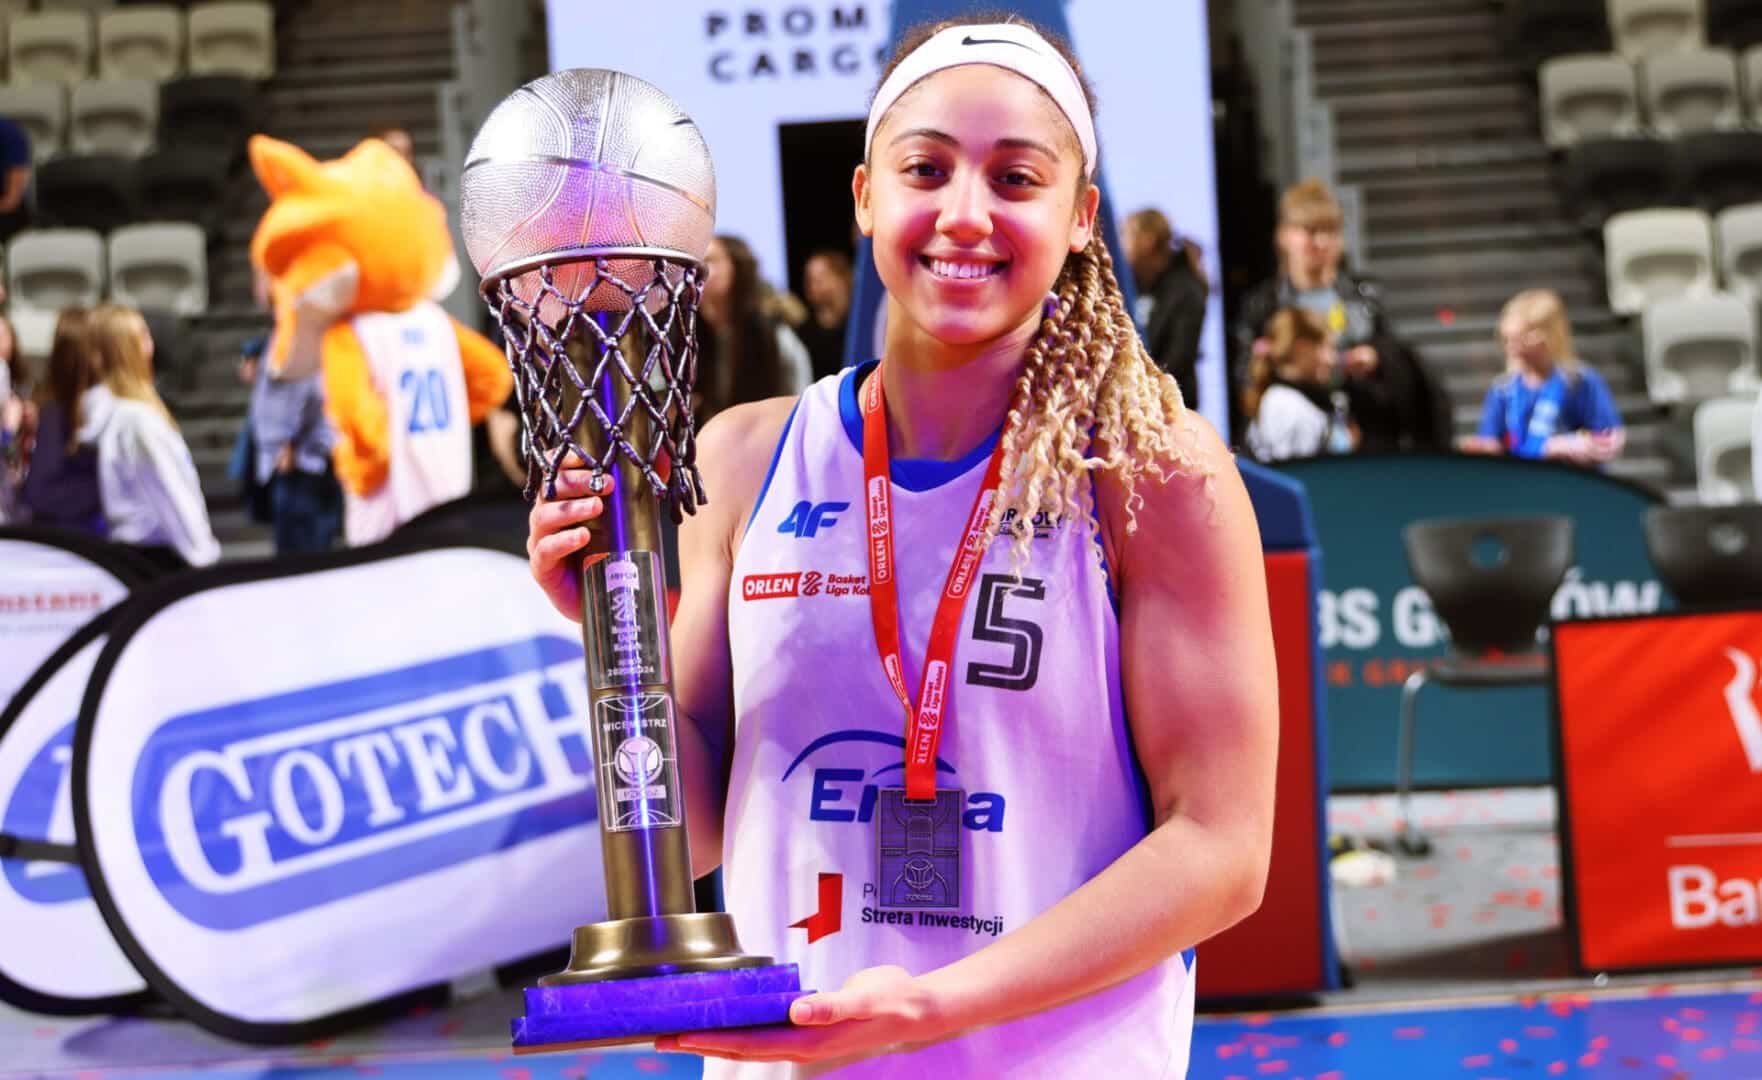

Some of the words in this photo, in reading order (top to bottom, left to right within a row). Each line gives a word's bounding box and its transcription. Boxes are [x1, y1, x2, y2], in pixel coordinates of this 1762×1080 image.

[401, 369, 450, 433] 20
[827, 573, 866, 585] Basket
[874, 539, 887, 580] ORLEN
[745, 577, 794, 595] ORLEN
[825, 586, 849, 596] Liga
[966, 573, 1045, 691] 5
[159, 666, 592, 894] GOTECH
[1667, 864, 1762, 929] Ba
[861, 907, 913, 924] Strefa
[918, 910, 1004, 936] Inwestycji
